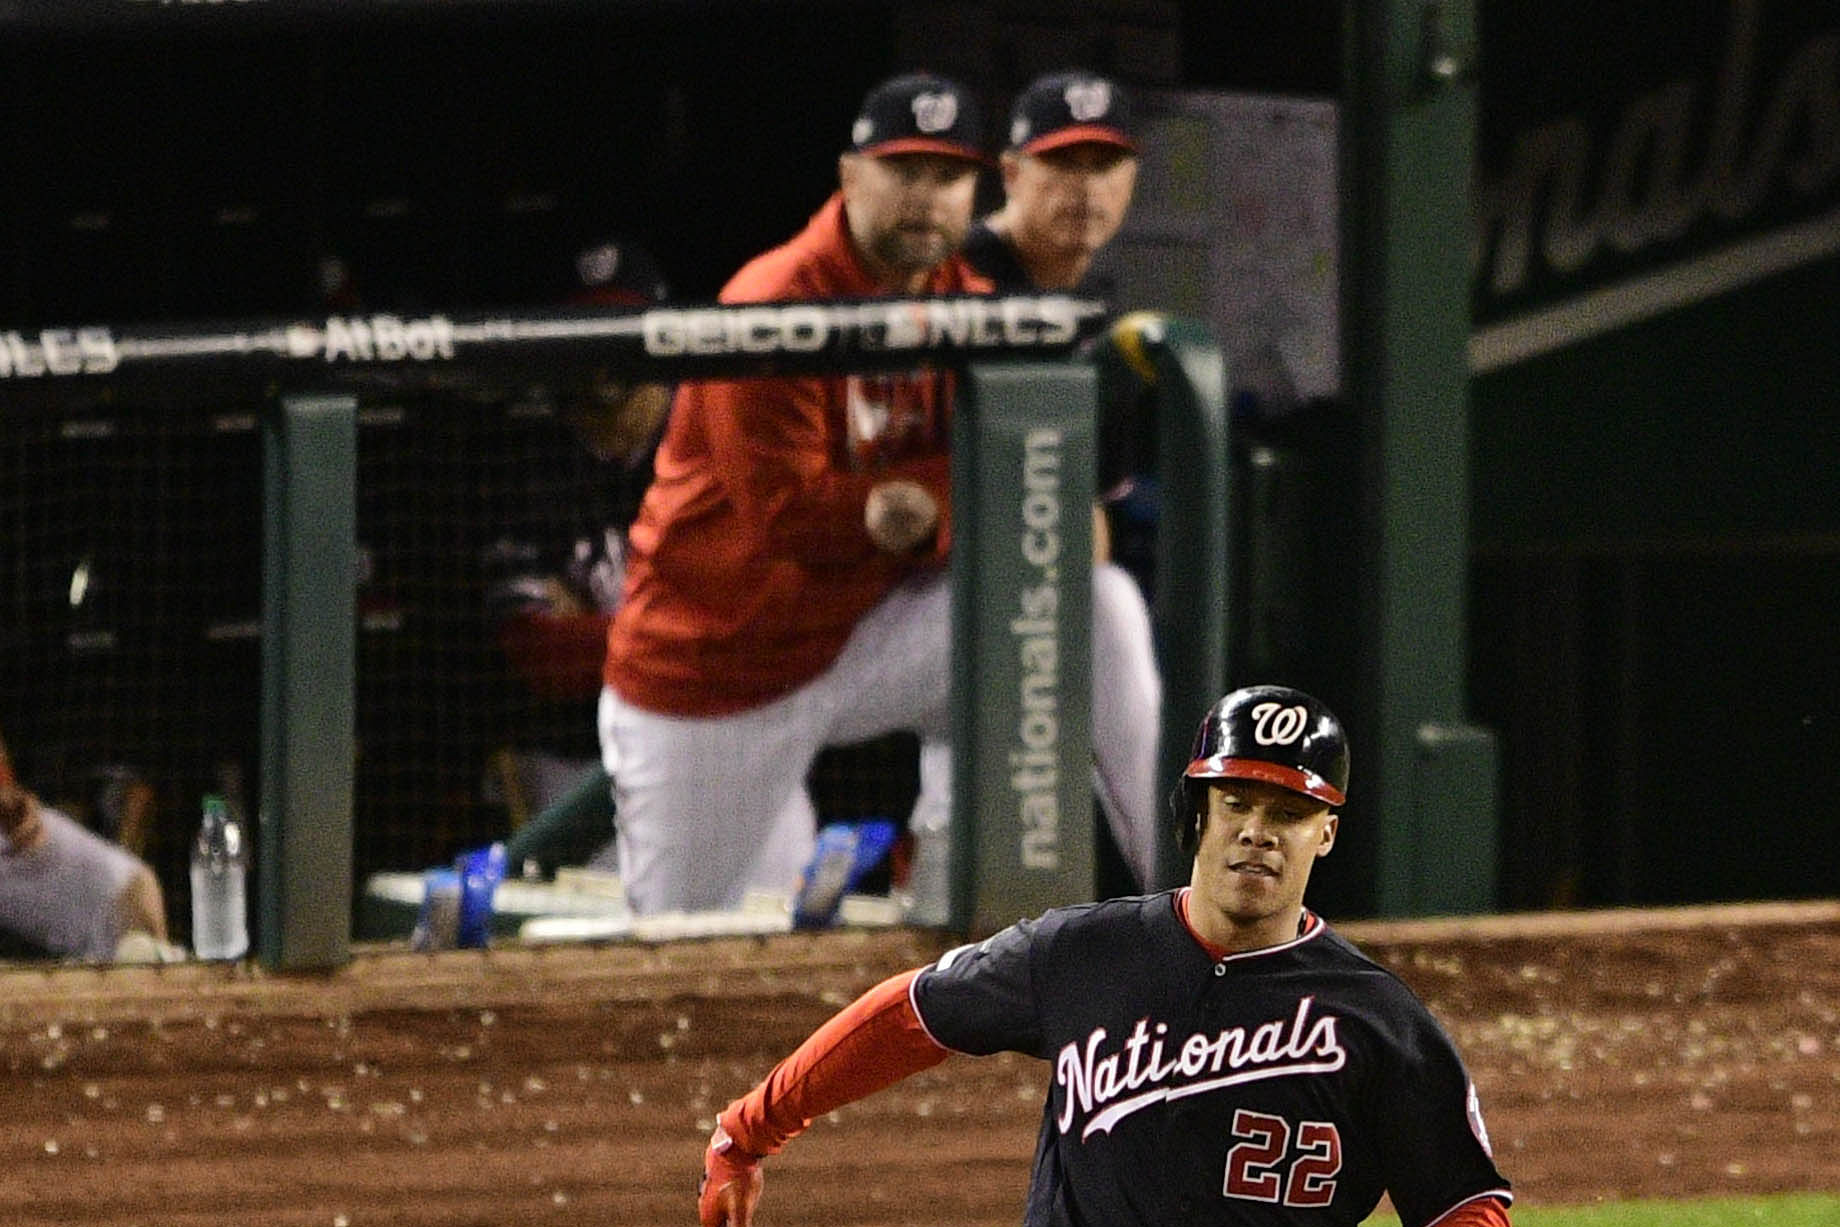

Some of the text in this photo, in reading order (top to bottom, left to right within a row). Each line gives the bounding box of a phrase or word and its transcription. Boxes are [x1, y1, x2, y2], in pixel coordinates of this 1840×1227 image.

[643, 304, 828, 356] GEICO
[1008, 428, 1062, 872] nationals.com
[1252, 702, 1308, 746] W
[1057, 996, 1346, 1143] Nationals
[1224, 1108, 1343, 1208] 22
